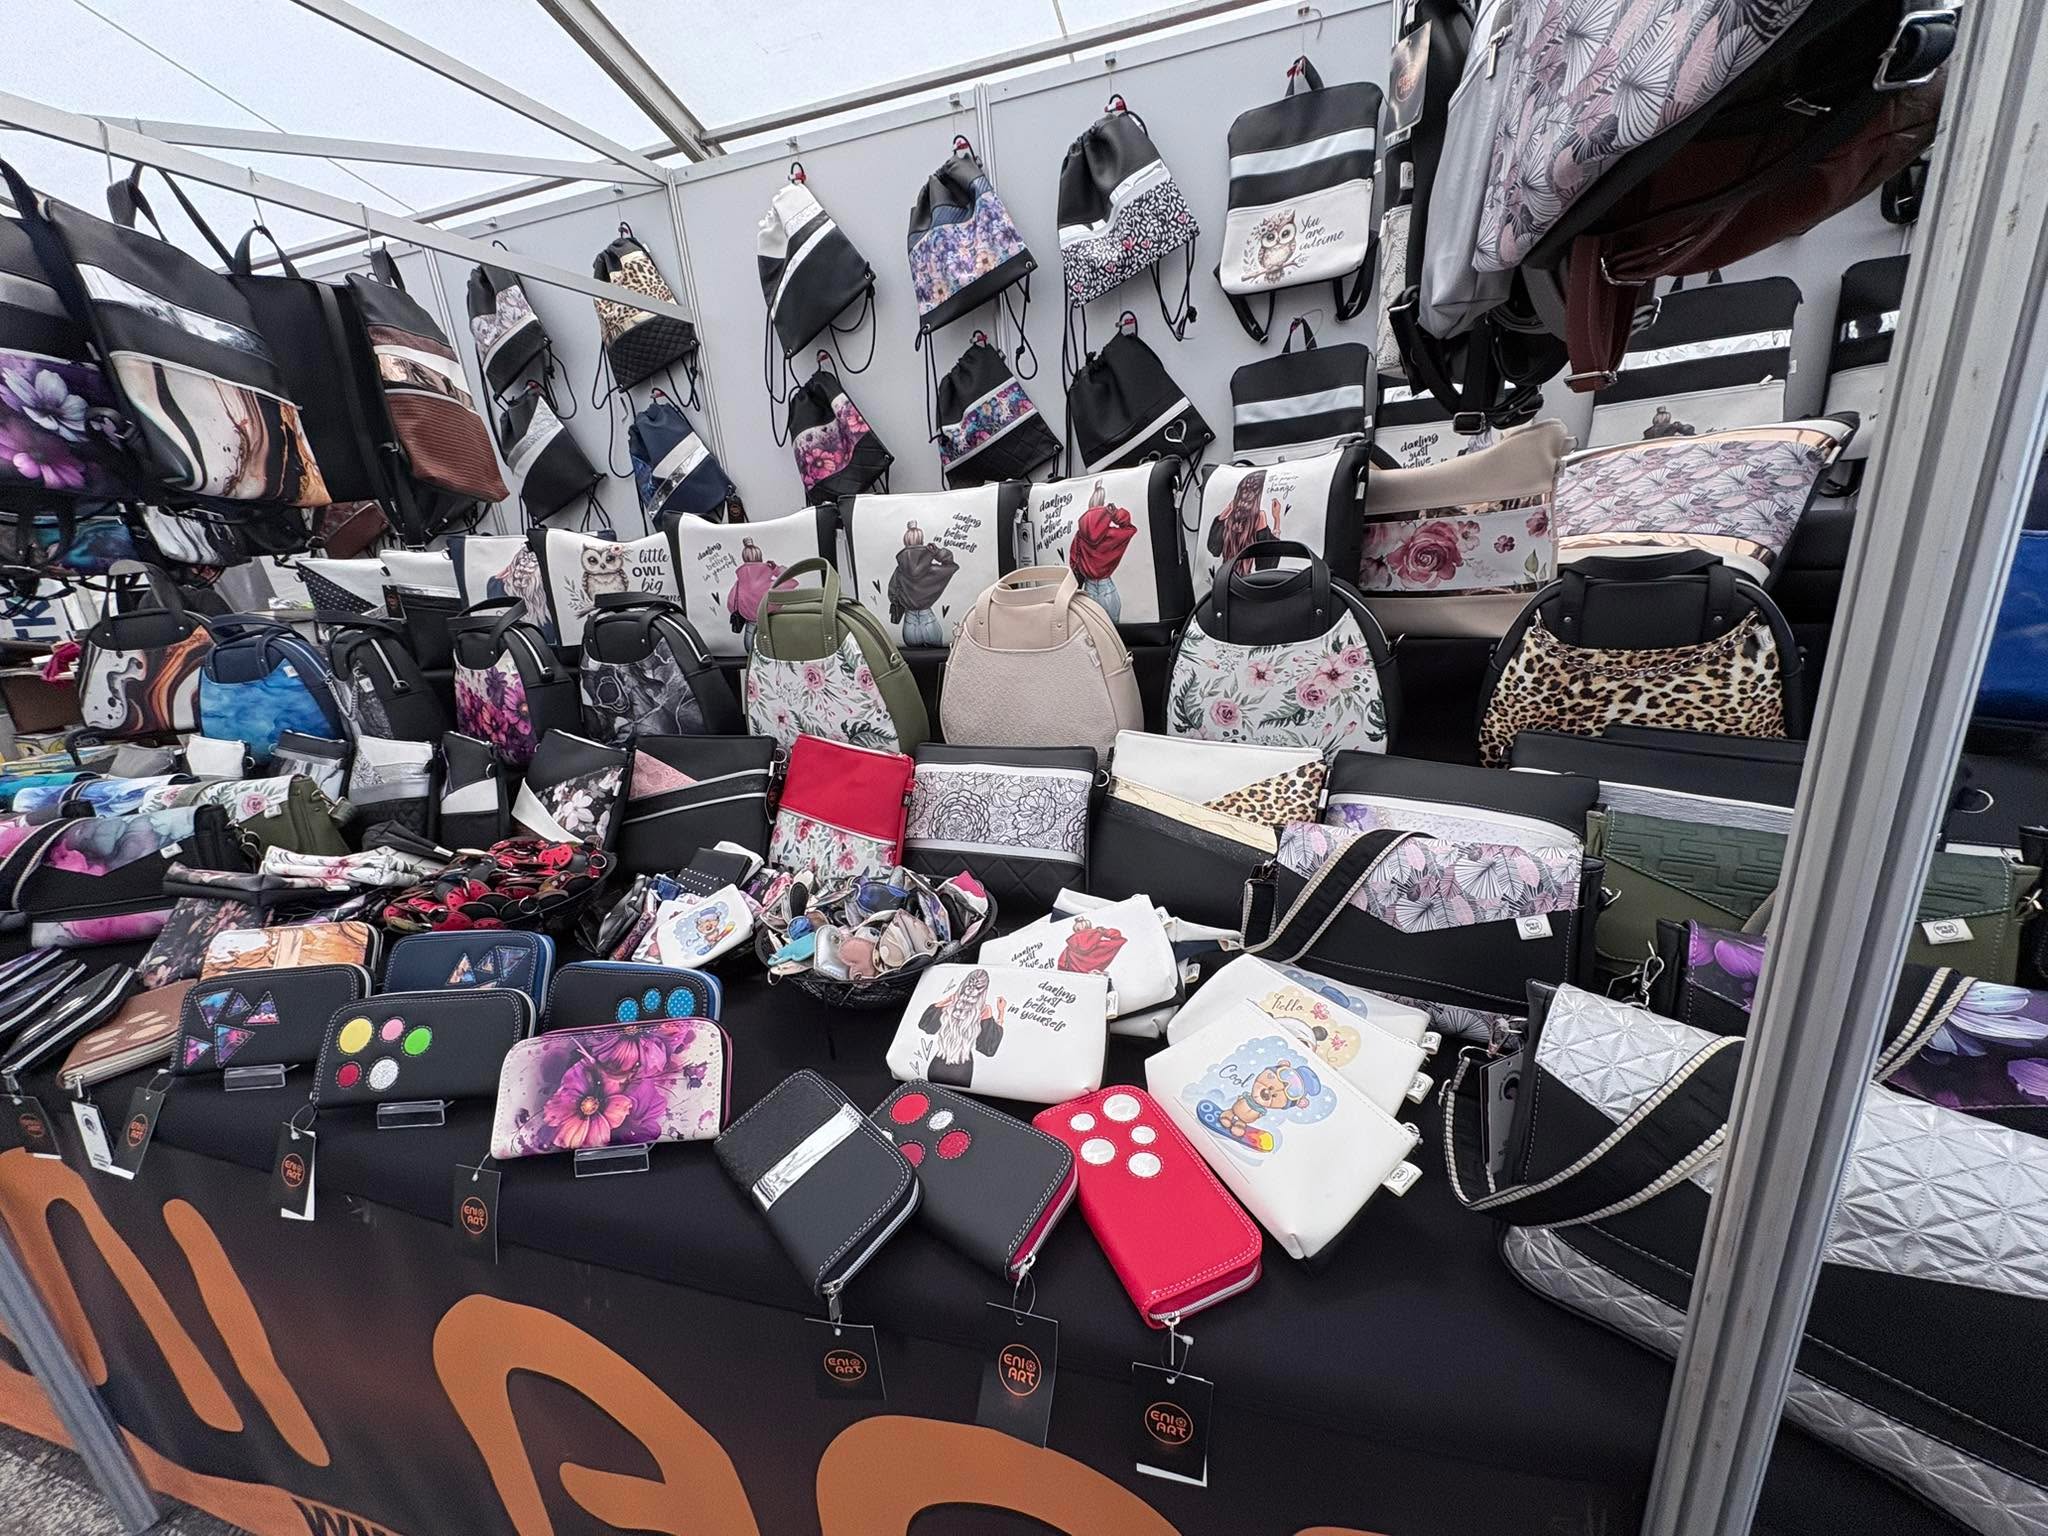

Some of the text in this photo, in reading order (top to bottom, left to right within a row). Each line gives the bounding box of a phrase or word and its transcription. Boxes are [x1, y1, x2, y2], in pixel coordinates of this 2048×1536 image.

[1299, 215, 1321, 234] You
[1305, 226, 1325, 240] are
[1400, 432, 1439, 452] darling
[1409, 444, 1429, 462] just
[1039, 493, 1073, 512] darling
[952, 512, 982, 528] darling
[1044, 505, 1064, 524] just
[639, 548, 670, 564] little
[632, 566, 665, 577] OWL
[641, 577, 664, 596] big
[1011, 942, 1043, 962] darling
[1036, 994, 1062, 1008] just
[1038, 981, 1076, 1004] darling
[1022, 998, 1056, 1016] belive
[1272, 993, 1304, 1012] hello
[1007, 1003, 1067, 1032] in yourself
[1219, 1064, 1255, 1088] Cool
[835, 1365, 862, 1374] ART
[1008, 1367, 1035, 1387] ART
[1156, 1422, 1186, 1438] ART
